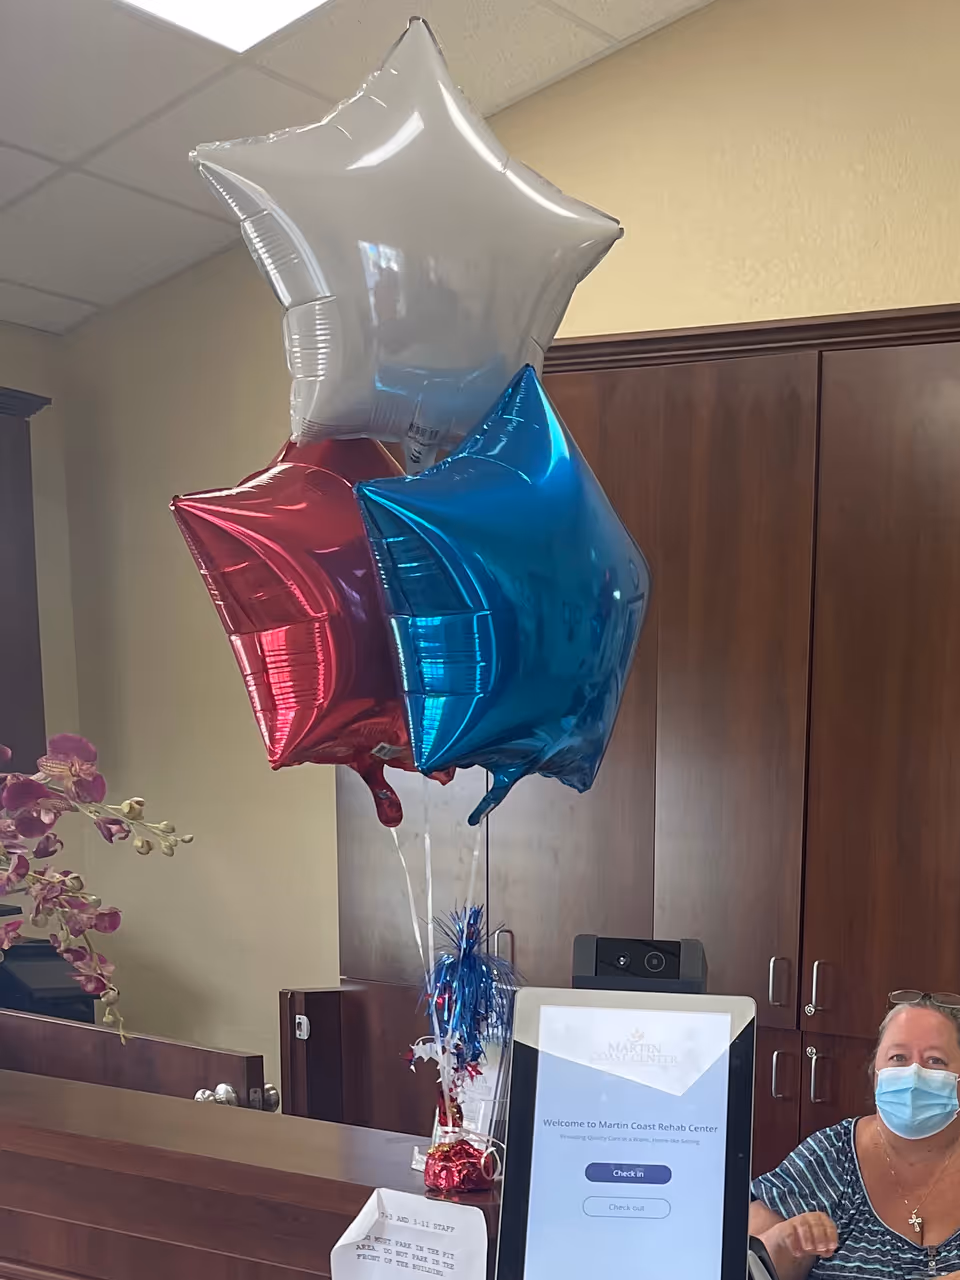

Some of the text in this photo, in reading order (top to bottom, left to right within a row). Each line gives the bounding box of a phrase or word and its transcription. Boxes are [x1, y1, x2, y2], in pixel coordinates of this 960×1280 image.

[608, 1041, 661, 1054] MARTIN
[631, 1053, 677, 1064] CENTER
[543, 1119, 585, 1128] Welcome
[599, 1120, 629, 1130] Martin
[631, 1122, 656, 1130] Coast
[658, 1123, 686, 1132] Rehab
[688, 1124, 718, 1133] Center
[613, 1169, 644, 1178] Check in
[608, 1203, 631, 1212] Check
[433, 1223, 455, 1232] STAFF
[395, 1240, 412, 1249] PARK
[427, 1247, 440, 1255] THE
[356, 1254, 380, 1262] FRONT
[396, 1260, 409, 1268] THE
[396, 1250, 408, 1258] NOT
[412, 1254, 428, 1263] PARK
[432, 1258, 440, 1266] IN
[442, 1262, 455, 1270] THE
